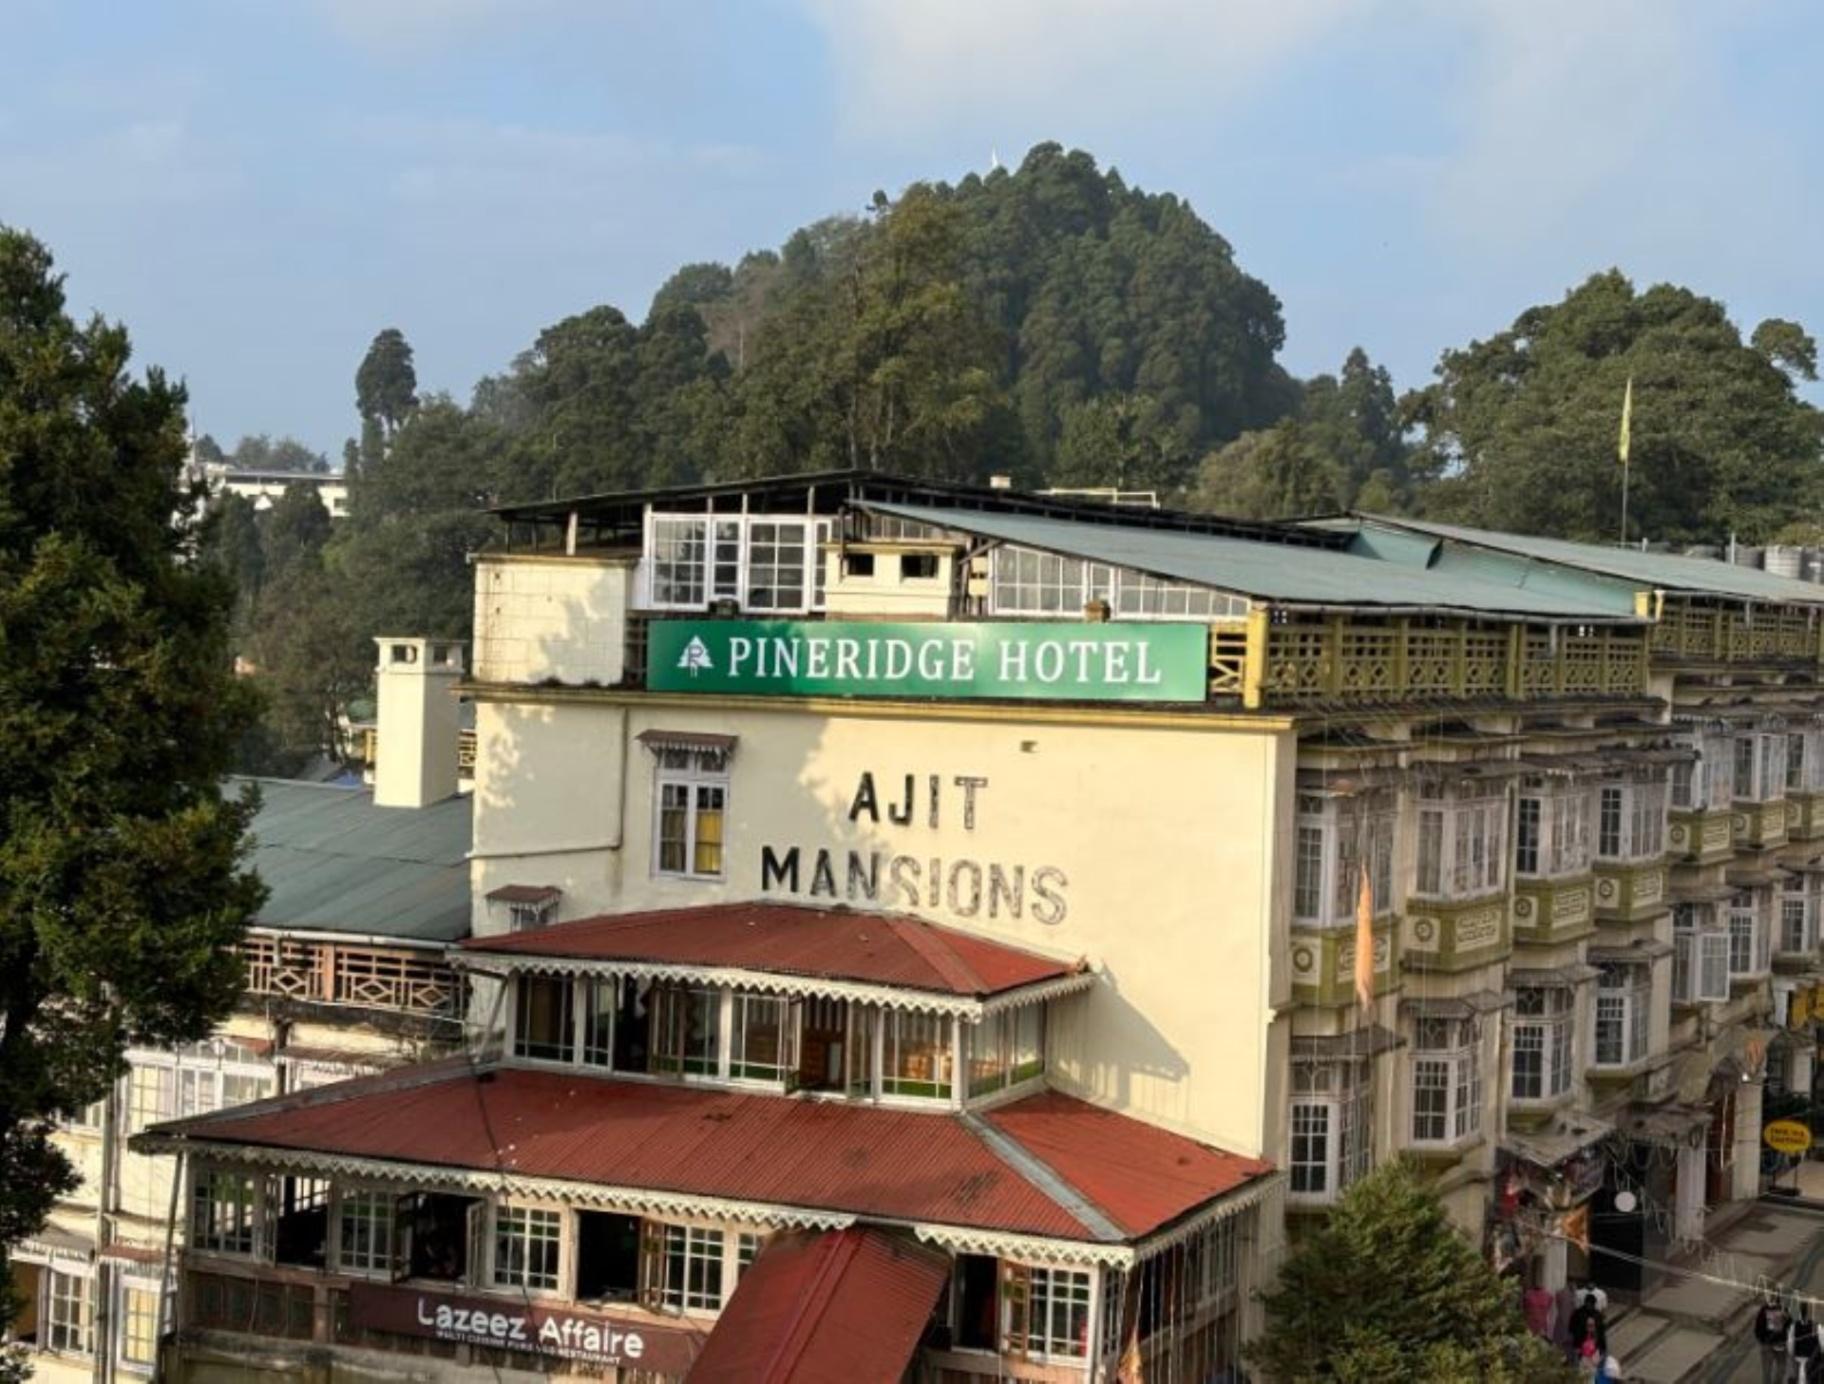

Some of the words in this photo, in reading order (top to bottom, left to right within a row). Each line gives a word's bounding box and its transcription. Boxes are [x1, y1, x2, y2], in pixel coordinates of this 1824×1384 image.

[728, 637, 976, 681] PINERIDGE
[997, 641, 1161, 684] HOTEL
[848, 771, 989, 830] AJIT
[761, 845, 1069, 925] MANSIONS
[417, 1298, 527, 1340] Lazeez
[538, 1317, 644, 1358] Affaire
